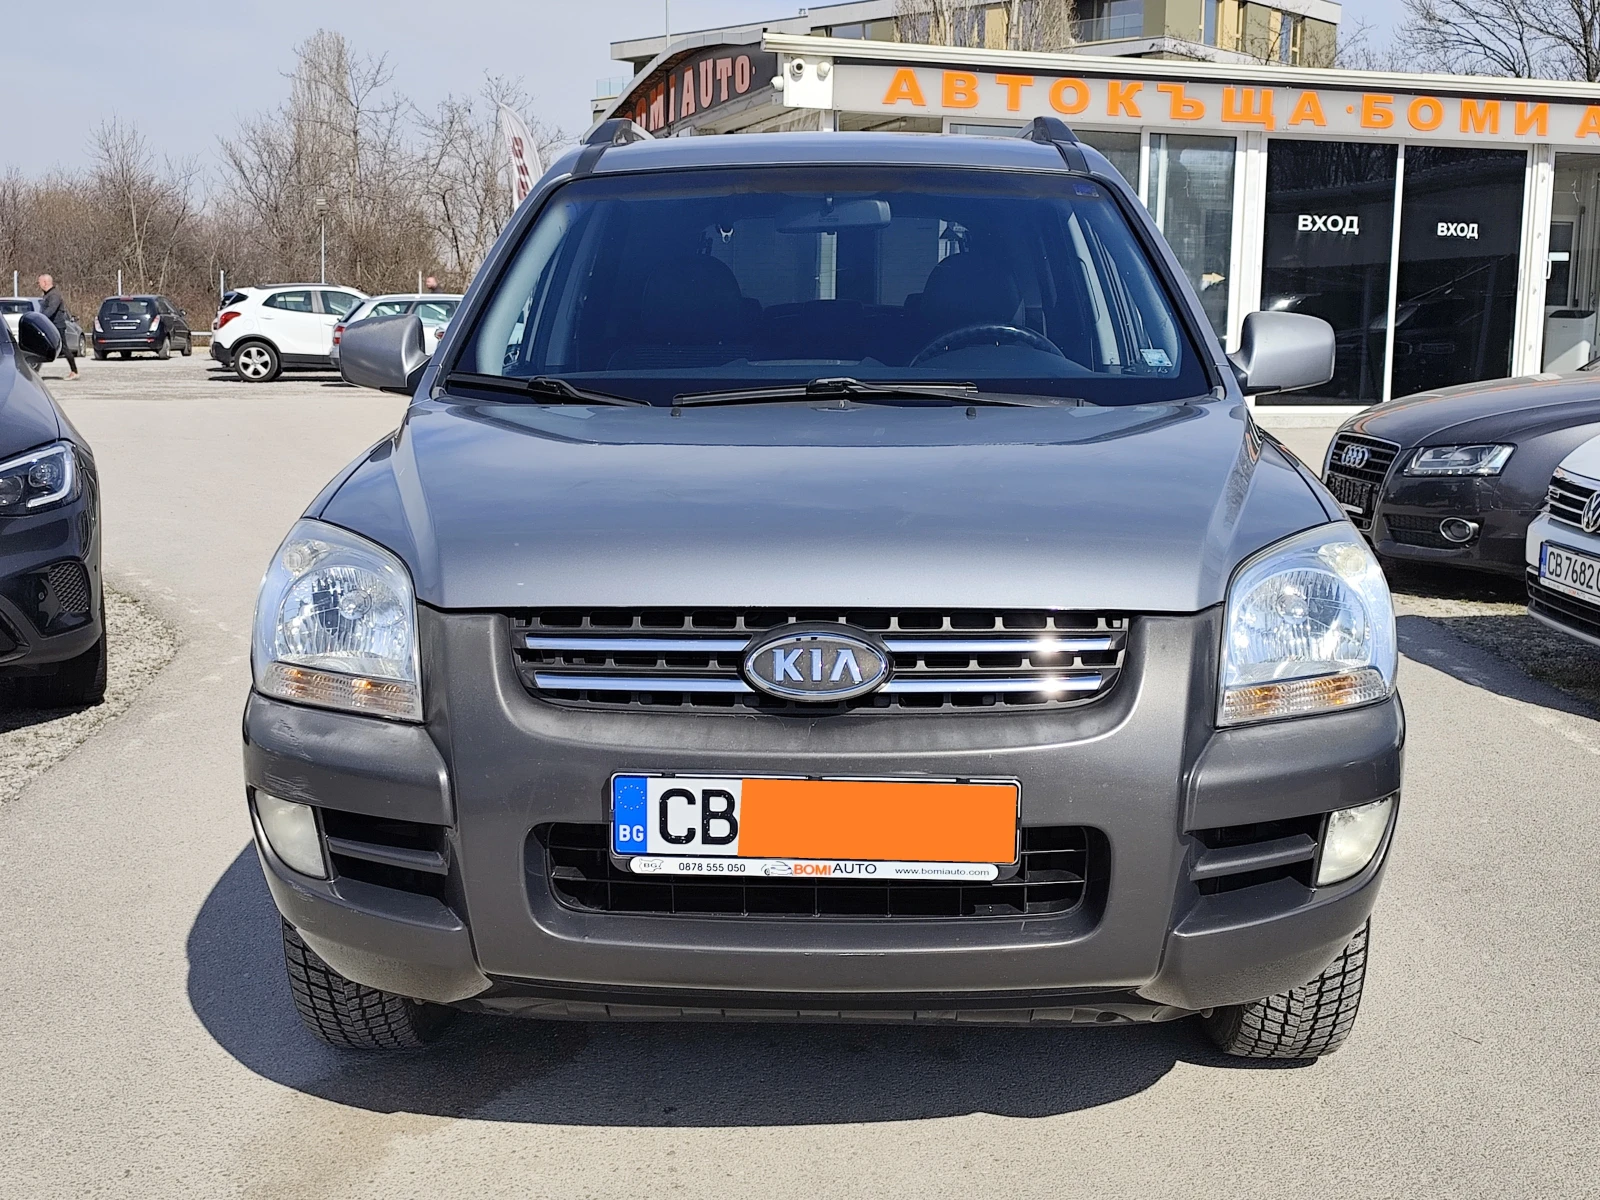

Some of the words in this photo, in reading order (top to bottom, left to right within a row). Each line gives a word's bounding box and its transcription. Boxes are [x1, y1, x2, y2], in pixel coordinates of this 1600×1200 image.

[882, 68, 1327, 131] АВТОКЪЩА
[1360, 93, 1549, 136] БОМИ
[1297, 214, 1360, 236] ВХОД
[1437, 222, 1479, 240] ВХОД
[773, 648, 863, 683] KIA
[659, 788, 738, 845] CB
[619, 824, 644, 842] BG
[678, 862, 703, 872] 0878
[706, 863, 725, 872] 555
[727, 864, 746, 873] 050
[894, 868, 990, 877] www.bomiauto.com
